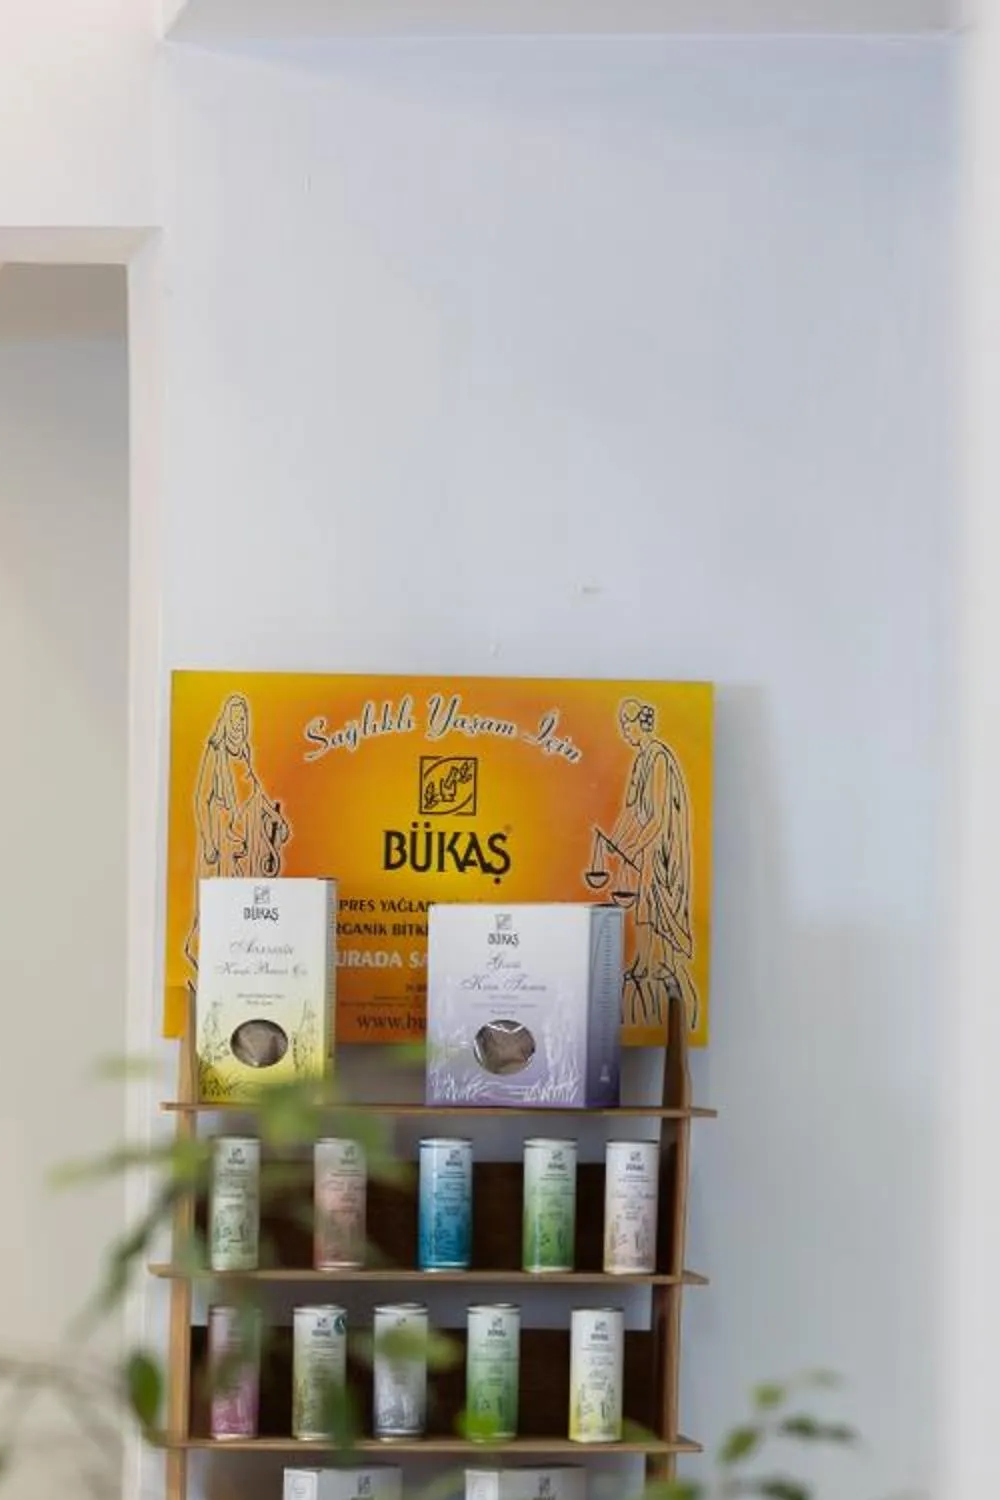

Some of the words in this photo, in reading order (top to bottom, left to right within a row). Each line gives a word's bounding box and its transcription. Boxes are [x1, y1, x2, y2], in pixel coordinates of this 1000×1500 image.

[305, 694, 413, 761] Sağlıklı
[426, 694, 516, 740] Yaşam
[384, 821, 511, 885] BÜKAŞ
